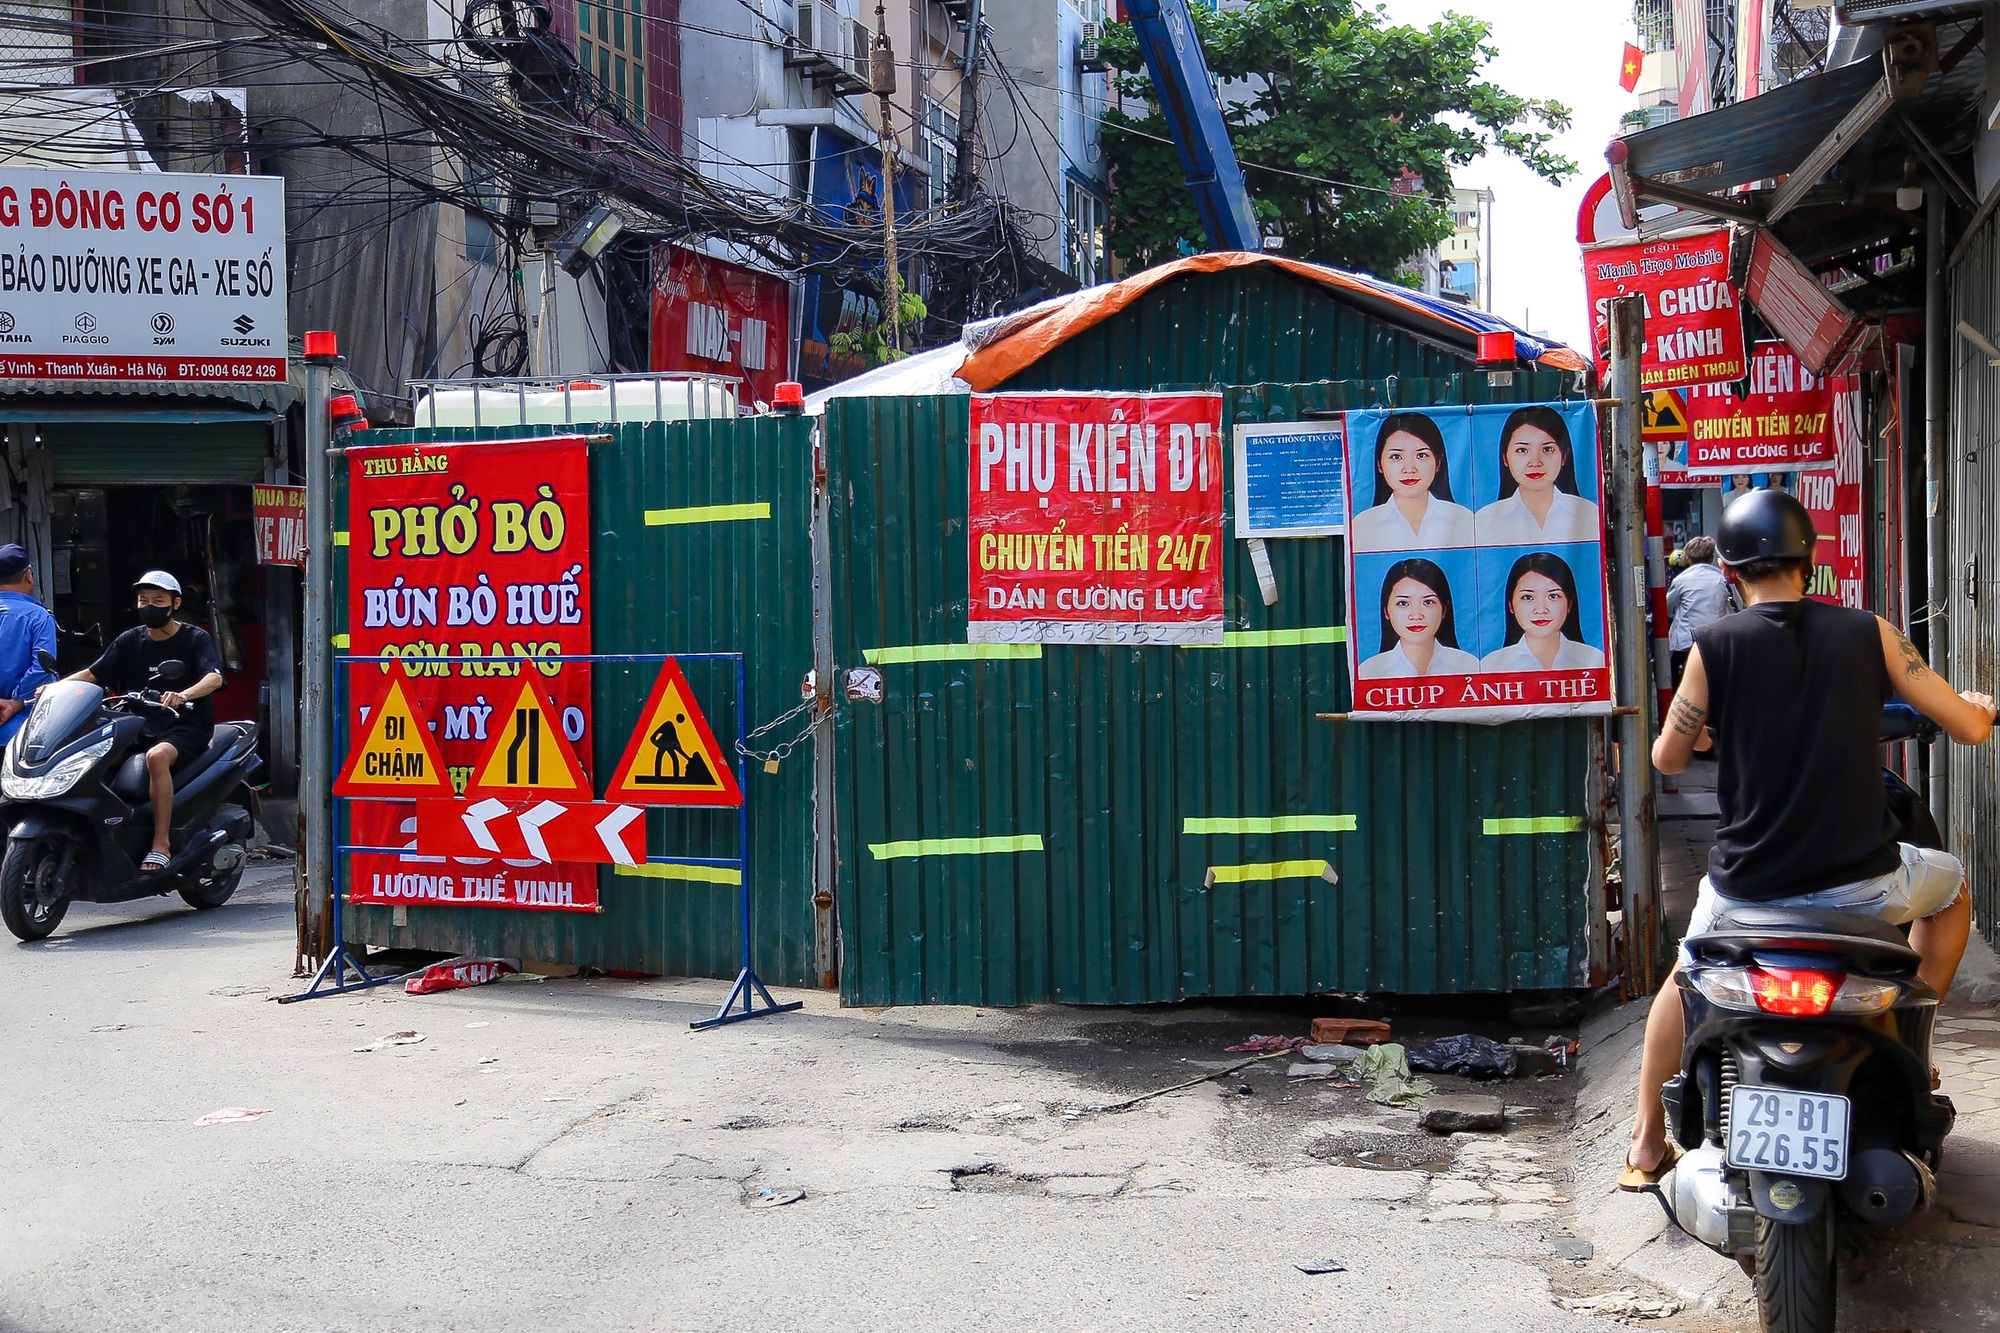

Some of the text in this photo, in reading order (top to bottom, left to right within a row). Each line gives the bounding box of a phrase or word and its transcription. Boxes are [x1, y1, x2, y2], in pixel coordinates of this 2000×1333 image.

[30, 180, 125, 230] ĐÔNG
[136, 191, 181, 232] CƠ
[192, 182, 234, 234] SỞ
[241, 196, 254, 234] 1
[2, 243, 46, 292] BẢO
[52, 247, 131, 294] DƯỠNG
[137, 257, 163, 295] XE
[169, 258, 199, 296] GA
[215, 259, 241, 296] XE
[246, 247, 273, 297] SỐ
[1598, 249, 1724, 282] Mạnh Trọc Mobile
[1659, 277, 1733, 316] CHỮA
[62, 335, 110, 344] PIAGGIO
[152, 337, 175, 346] SYM
[220, 338, 271, 346] SUZUKI
[1657, 327, 1724, 362] KÍNH
[45, 362, 84, 375] Thanh
[86, 362, 117, 376] Xuân
[127, 363, 144, 376] Hà
[147, 363, 167, 379] Nội
[231, 364, 253, 377] 642
[255, 364, 276, 377] 426
[1667, 365, 1699, 383] ĐIỆN
[1693, 409, 1827, 441] CHUYỂN TIỀN 24/7
[364, 448, 449, 474] THU HẰNG
[980, 408, 1212, 509] PHỤ KIỆN ĐT
[1698, 441, 1823, 461] DÁN CƯỜNG LỰC
[254, 489, 285, 507] MUA
[370, 484, 565, 557] PHỞ BÒ
[979, 518, 1212, 572] CHUYỂN TIỀN 24/7
[1840, 514, 1859, 568] PHỤ
[364, 564, 582, 627] BÚN BÒ HUẾ
[988, 583, 1204, 615] DÁN CƯỜNG LỰC
[380, 641, 562, 677] CƠM RANG
[1365, 671, 1598, 709] CHỤP ẢNH THẺ
[385, 716, 405, 741] ĐI
[444, 695, 493, 740] MỲ
[365, 748, 424, 781] CHẬM
[373, 871, 573, 905] LƯƠNG THẾ VINH
[1747, 1093, 1829, 1134] 29-B1
[1736, 1130, 1839, 1172] 226.55
